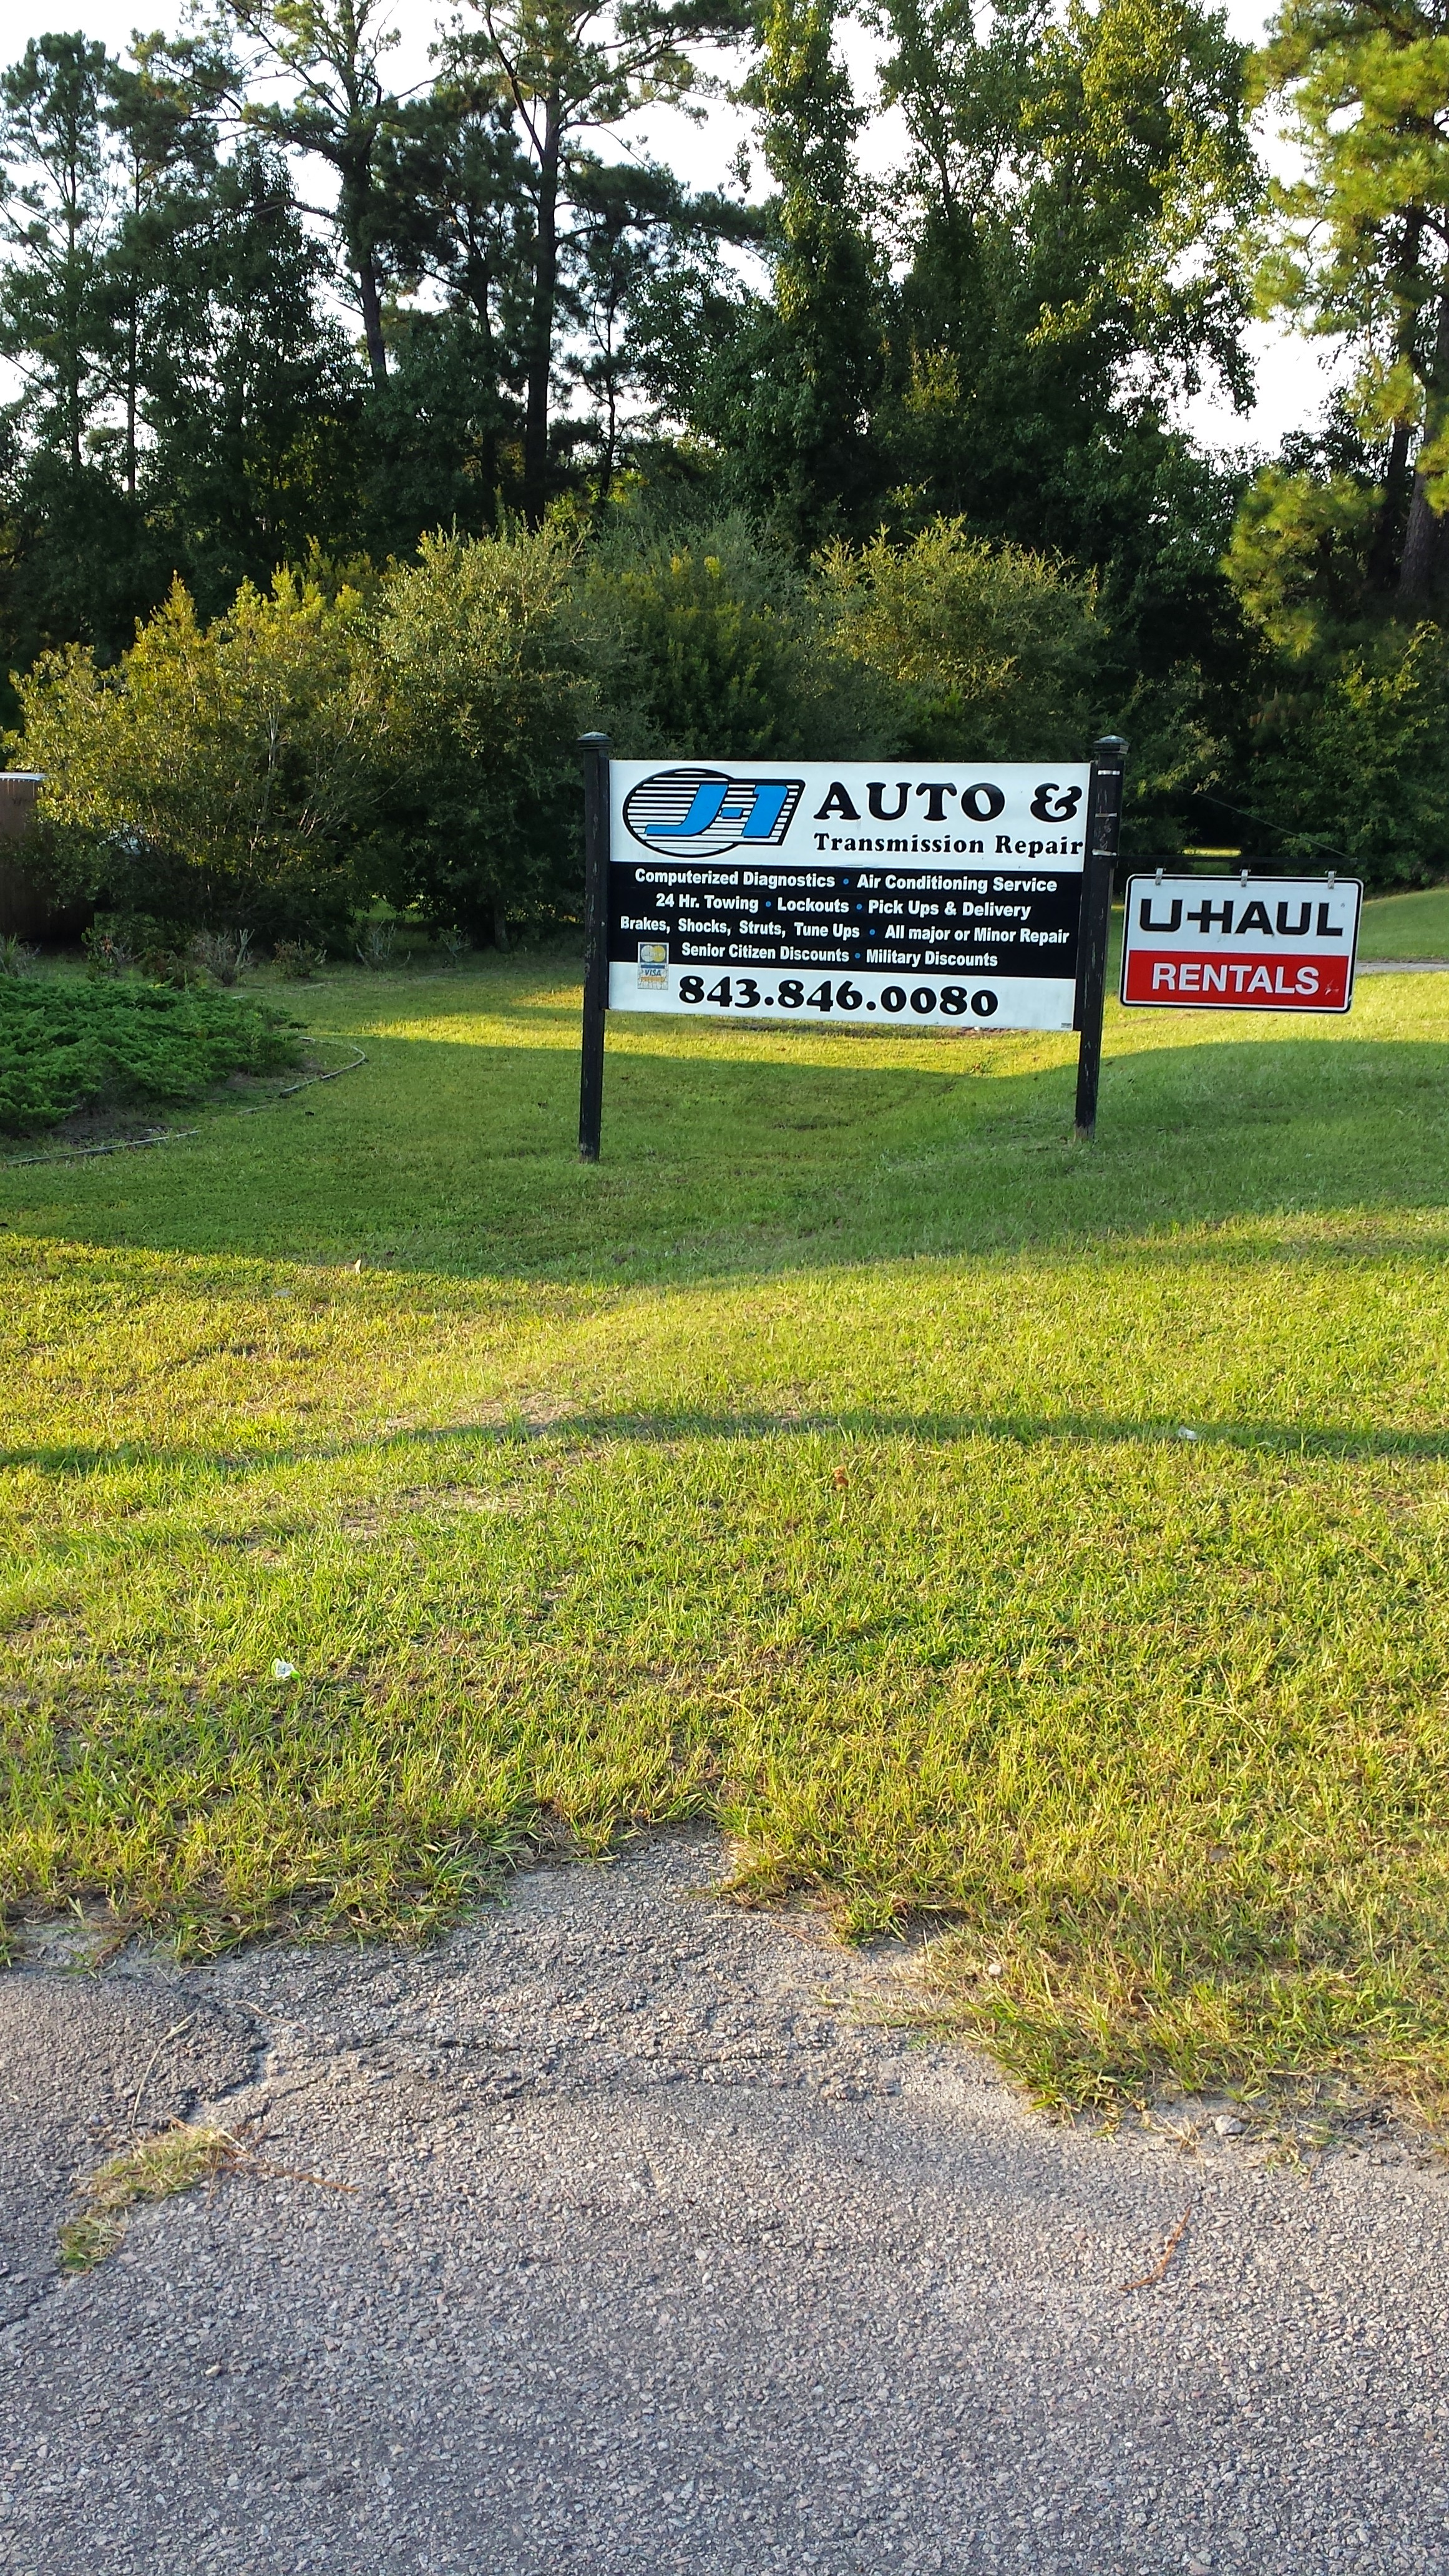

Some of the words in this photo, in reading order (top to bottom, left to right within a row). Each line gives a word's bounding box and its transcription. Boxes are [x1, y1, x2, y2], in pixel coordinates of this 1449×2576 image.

[645, 783, 788, 838] J-1
[813, 781, 1005, 821] AUTO
[1030, 783, 1083, 822] &
[814, 832, 984, 854] Transmission
[995, 835, 1083, 858] Repair
[635, 868, 738, 886] Computerized
[743, 872, 835, 889] Diagnostics
[857, 874, 881, 889] Air
[885, 874, 988, 894] Conditioning
[993, 877, 1057, 892] Service
[656, 893, 675, 907] 24
[679, 894, 700, 908] Hr.
[704, 895, 759, 913] Towing
[778, 897, 849, 913] Lockouts
[868, 899, 904, 914] Pick
[908, 900, 939, 918] Ups
[944, 901, 957, 916] &
[962, 902, 1032, 920] Delivery
[1139, 899, 1344, 936] U-HAUL
[620, 916, 670, 934] Brakes,
[678, 918, 731, 936] Shocks,
[739, 920, 786, 938] Struts,
[794, 922, 829, 937] Tune
[832, 924, 860, 940] Ups
[884, 924, 904, 939] All
[909, 927, 950, 944] major
[954, 929, 970, 941] or
[973, 927, 1016, 942] Minor
[1020, 928, 1070, 946] Repair
[681, 942, 725, 957] Senior
[729, 944, 776, 959] Citizen
[780, 945, 849, 962] Discounts
[866, 949, 921, 968] Military
[925, 950, 998, 967] Discounts
[1152, 962, 1319, 995] RENTALS
[679, 975, 998, 1017] 843.846.0080
